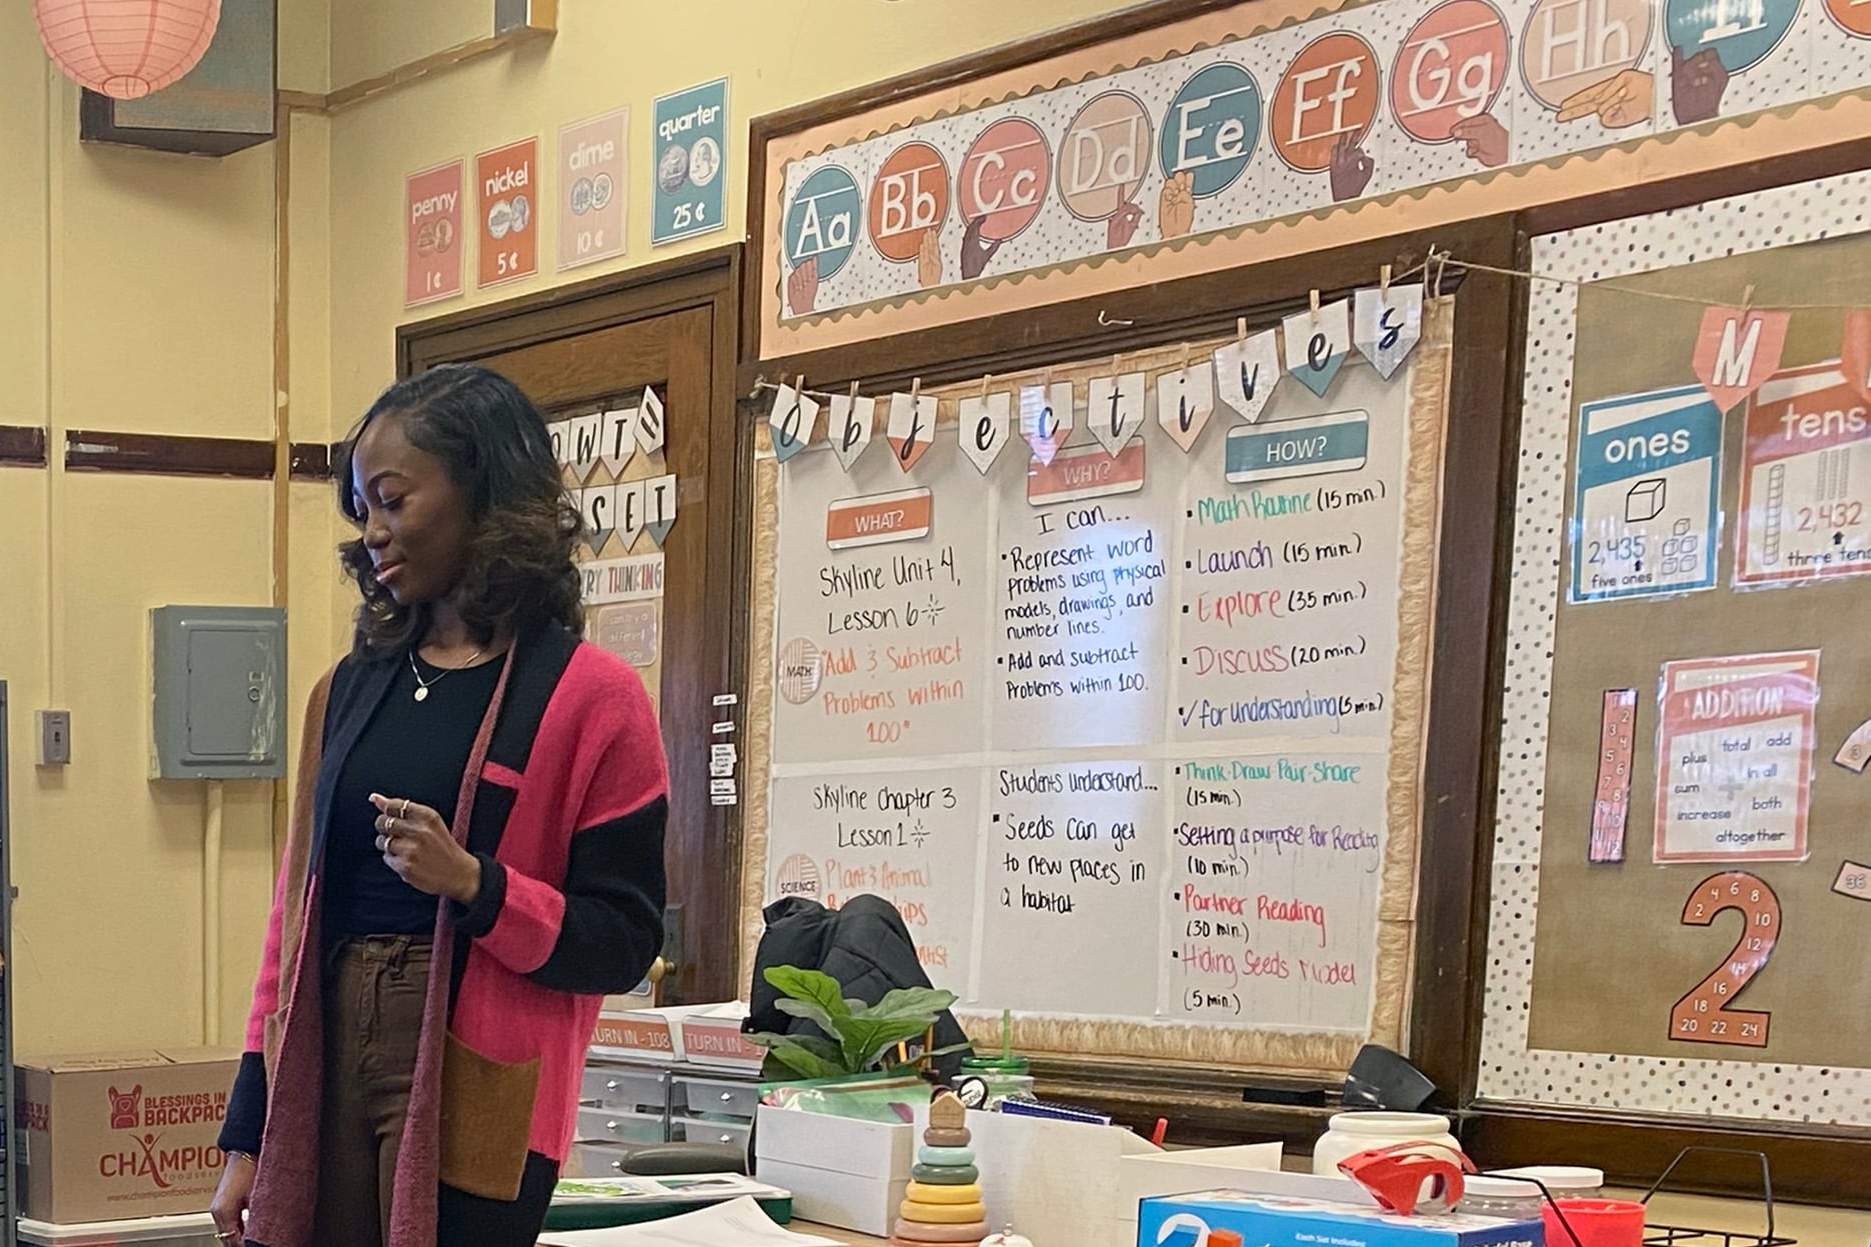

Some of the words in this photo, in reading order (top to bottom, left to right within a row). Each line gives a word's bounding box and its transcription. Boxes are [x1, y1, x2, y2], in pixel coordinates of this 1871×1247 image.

[659, 104, 719, 140] quarter
[569, 139, 614, 170] dime
[485, 161, 528, 197] nickel
[412, 190, 457, 224] penny
[1780, 402, 1868, 441] tens
[1266, 435, 1327, 463] HOW?
[1604, 427, 1691, 464] ones
[1064, 461, 1111, 486] WHY?
[855, 510, 905, 533] WHAT?
[1034, 512, 1055, 535] I
[1797, 502, 1863, 533] 2,432
[1010, 546, 1095, 573] Represent
[1107, 529, 1153, 558] word
[1198, 540, 1274, 575] Launch
[1588, 537, 1647, 565] 2,435
[608, 563, 662, 593] THINKING
[820, 564, 885, 598] Skyline
[893, 555, 933, 586] Unit
[1072, 570, 1107, 595] using
[1591, 573, 1617, 588] five
[1622, 571, 1653, 586] ones
[1005, 601, 1056, 620] models,
[1126, 586, 1154, 607] and
[1198, 589, 1285, 629] Explore
[829, 607, 899, 634] Lesson
[1007, 623, 1059, 639] number
[1068, 620, 1105, 637] lines.
[887, 637, 962, 671] Subtract
[1008, 651, 1033, 672] Add
[1039, 651, 1064, 667] and
[1070, 642, 1139, 667] subtract
[1193, 644, 1290, 676] Discuss
[824, 692, 895, 715] Problems
[908, 679, 964, 705] within
[1070, 676, 1112, 694] within
[1119, 672, 1149, 693] 100.
[1198, 698, 1228, 730] for
[1231, 690, 1340, 734] understanding
[1692, 686, 1784, 720] ADDITION
[1722, 738, 1751, 752] total
[1766, 733, 1792, 747] add
[1682, 752, 1707, 766] plus
[1763, 764, 1777, 777] all
[1000, 768, 1063, 797] Students
[1674, 783, 1700, 794] sum
[814, 783, 868, 813] Skyline
[878, 786, 935, 817] Chapter
[941, 787, 957, 809] 3
[1752, 797, 1782, 810] both
[1677, 809, 1731, 821] increase
[838, 822, 892, 848] Lesson
[1005, 813, 1055, 840] Seeds
[1111, 822, 1135, 852] get
[1716, 829, 1786, 845] altogether
[1179, 822, 1238, 860] Setting
[1253, 825, 1304, 855] purpose
[1308, 824, 1328, 847] for
[1331, 826, 1379, 873] Reading
[882, 861, 931, 890] Animal
[1003, 852, 1020, 872] to
[1028, 855, 1062, 875] new
[1070, 858, 1120, 885] places
[1130, 860, 1145, 882] in
[780, 881, 816, 894] SCIENCE
[1001, 888, 1011, 907] a
[1022, 884, 1075, 914] habitat
[1184, 883, 1247, 915] Partner
[1257, 895, 1326, 948] Reading
[1755, 913, 1771, 926] 10
[1747, 938, 1761, 951] 12
[1182, 942, 1238, 989] Hiding
[1242, 949, 1289, 979] Seeds
[1713, 983, 1727, 994] 16
[1694, 1000, 1708, 1012] 18
[625, 1029, 638, 1045] IN
[649, 1032, 670, 1049] 108
[1681, 1019, 1697, 1032] 20
[1711, 1021, 1727, 1034] 22
[1741, 1023, 1758, 1036] 24
[686, 1033, 722, 1050] TURN
[724, 1038, 741, 1053] IN
[144, 1093, 209, 1109] BLESSINGS
[213, 1092, 226, 1104] IN
[144, 1104, 225, 1127] BACKPAC
[100, 1141, 222, 1184] CHAMPIO
